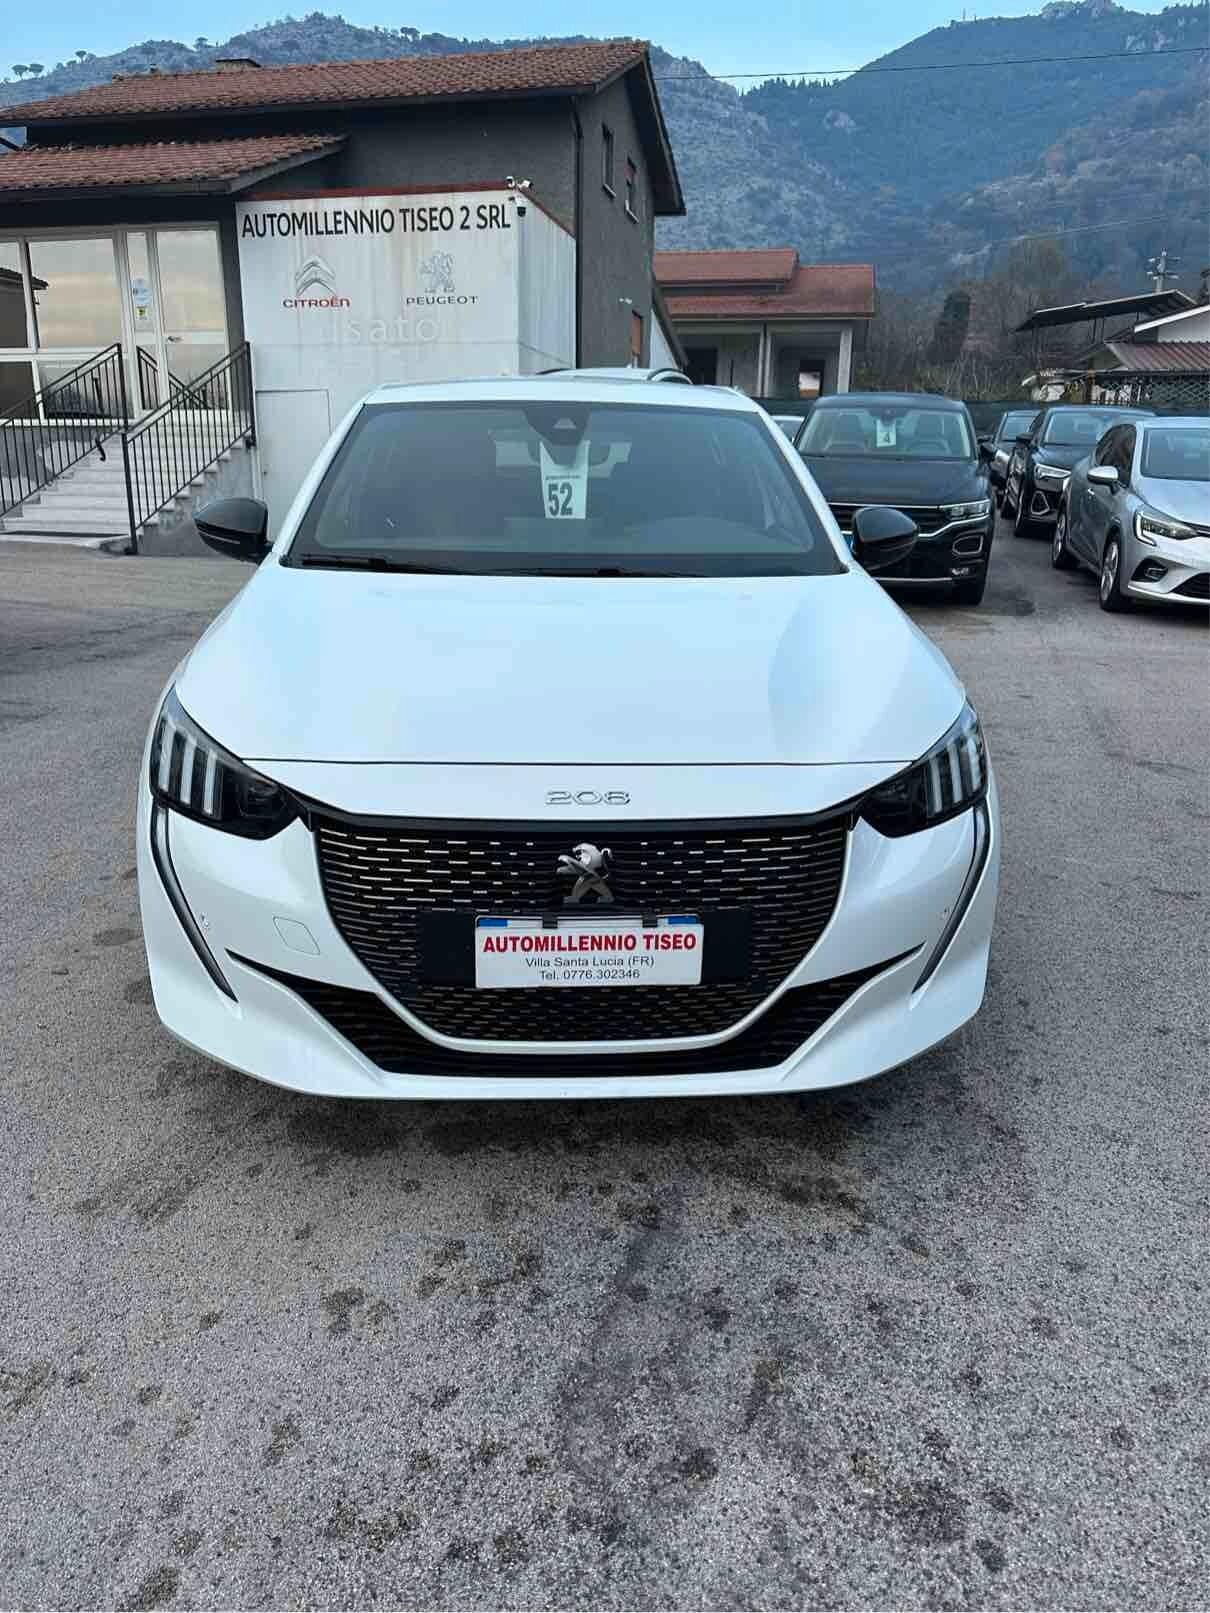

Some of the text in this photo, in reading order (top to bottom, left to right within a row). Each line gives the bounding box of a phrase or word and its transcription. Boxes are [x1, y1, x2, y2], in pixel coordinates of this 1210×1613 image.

[242, 204, 511, 237] AUTOMILLENNIO TISEO 2 SRL
[283, 296, 350, 308] CITROËN
[406, 295, 478, 305] PEUGEOT
[548, 482, 573, 516] 52
[483, 934, 697, 952] AUTOMILLENNIO TISEO
[525, 955, 655, 968] Villa Santa Lucia (FR)
[541, 969, 640, 980] Tel. 0776.302346
